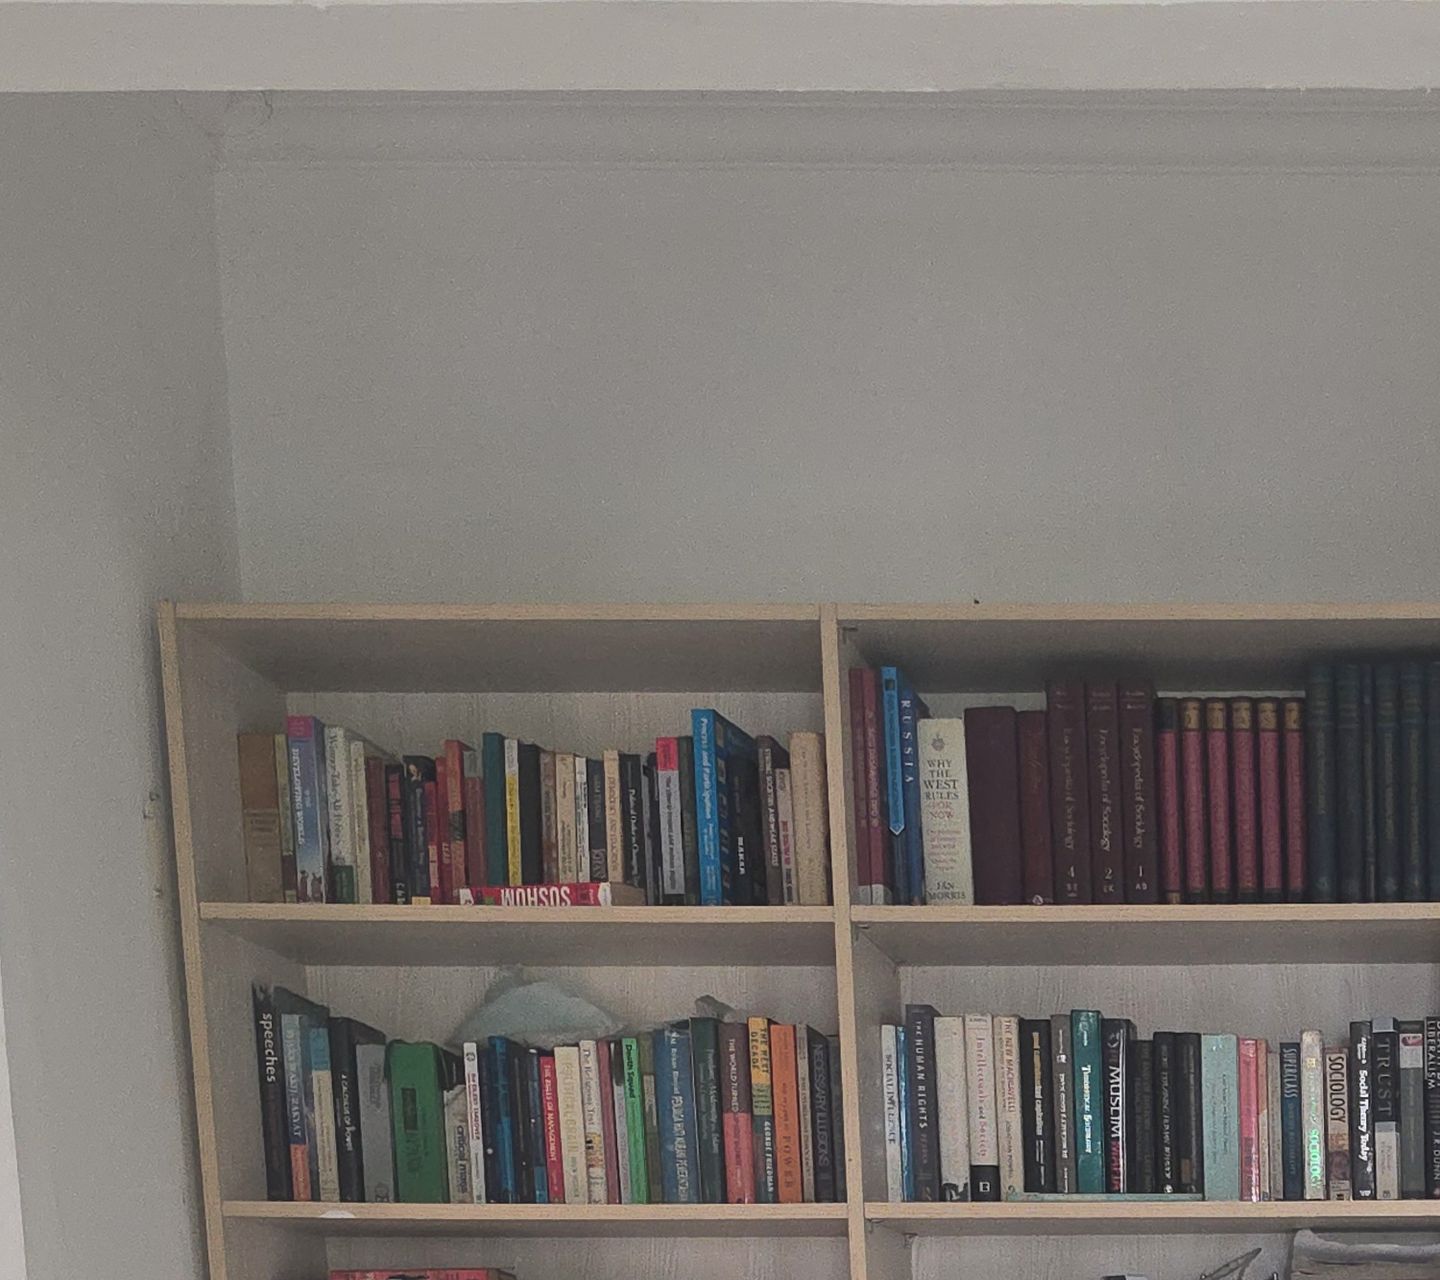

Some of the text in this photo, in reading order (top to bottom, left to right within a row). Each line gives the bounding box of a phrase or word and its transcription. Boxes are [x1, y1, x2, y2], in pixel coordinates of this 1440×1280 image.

[901, 700, 914, 782] RUSSIA
[927, 760, 952, 768] WHY
[930, 770, 950, 778] THE
[924, 780, 958, 790] WEST
[1100, 729, 1112, 852] Encyclopedia of Sociology
[1133, 728, 1144, 848] Encyclopedia of Sociology
[261, 1013, 277, 1082] speeches
[625, 1044, 634, 1070] Death
[750, 1032, 760, 1070] DECADE
[1283, 1048, 1298, 1098] SUPERCLASS
[1376, 1038, 1391, 1116] TRUST
[1427, 1021, 1437, 1089] LIBERALISM
[812, 1044, 829, 1167] NECESSARY ILLUSIONS
[916, 1039, 928, 1128] HUMAN RIGHTS
[1109, 1065, 1121, 1138] MUSLIM
[1328, 1057, 1346, 1123] SOCIOLOGY
[1358, 1070, 1370, 1161] Social Theory Today
[457, 1126, 468, 1194] critical mass
[1308, 1129, 1321, 1188] SOCIOLOGY
[1433, 1150, 1440, 1181] DUNN
